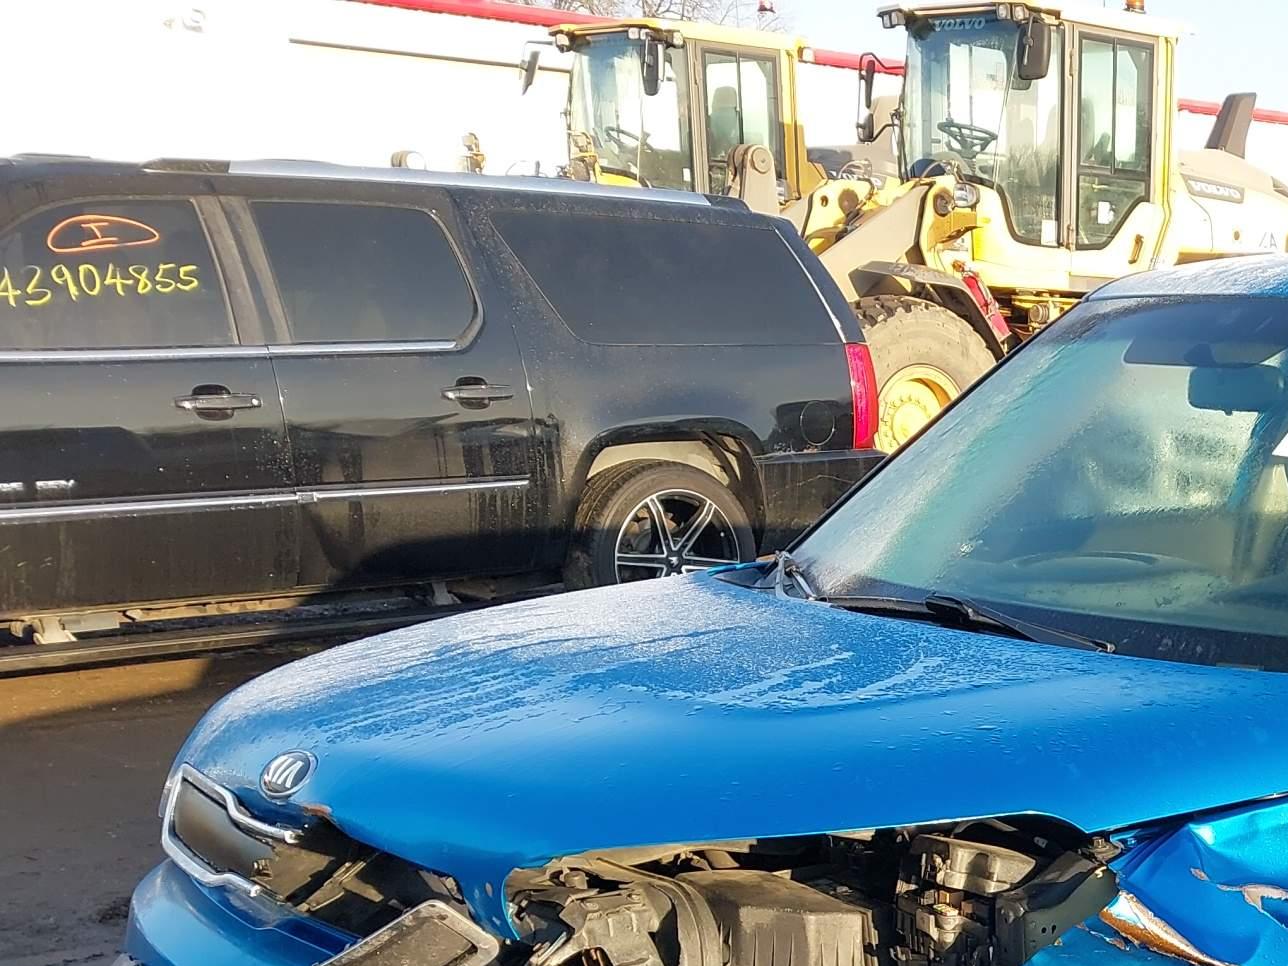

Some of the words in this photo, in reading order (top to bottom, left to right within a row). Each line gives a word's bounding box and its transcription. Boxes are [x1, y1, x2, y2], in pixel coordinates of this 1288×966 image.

[933, 17, 986, 32] VOLVO
[1187, 179, 1241, 199] VOLVO
[0, 262, 200, 307] 43904855
